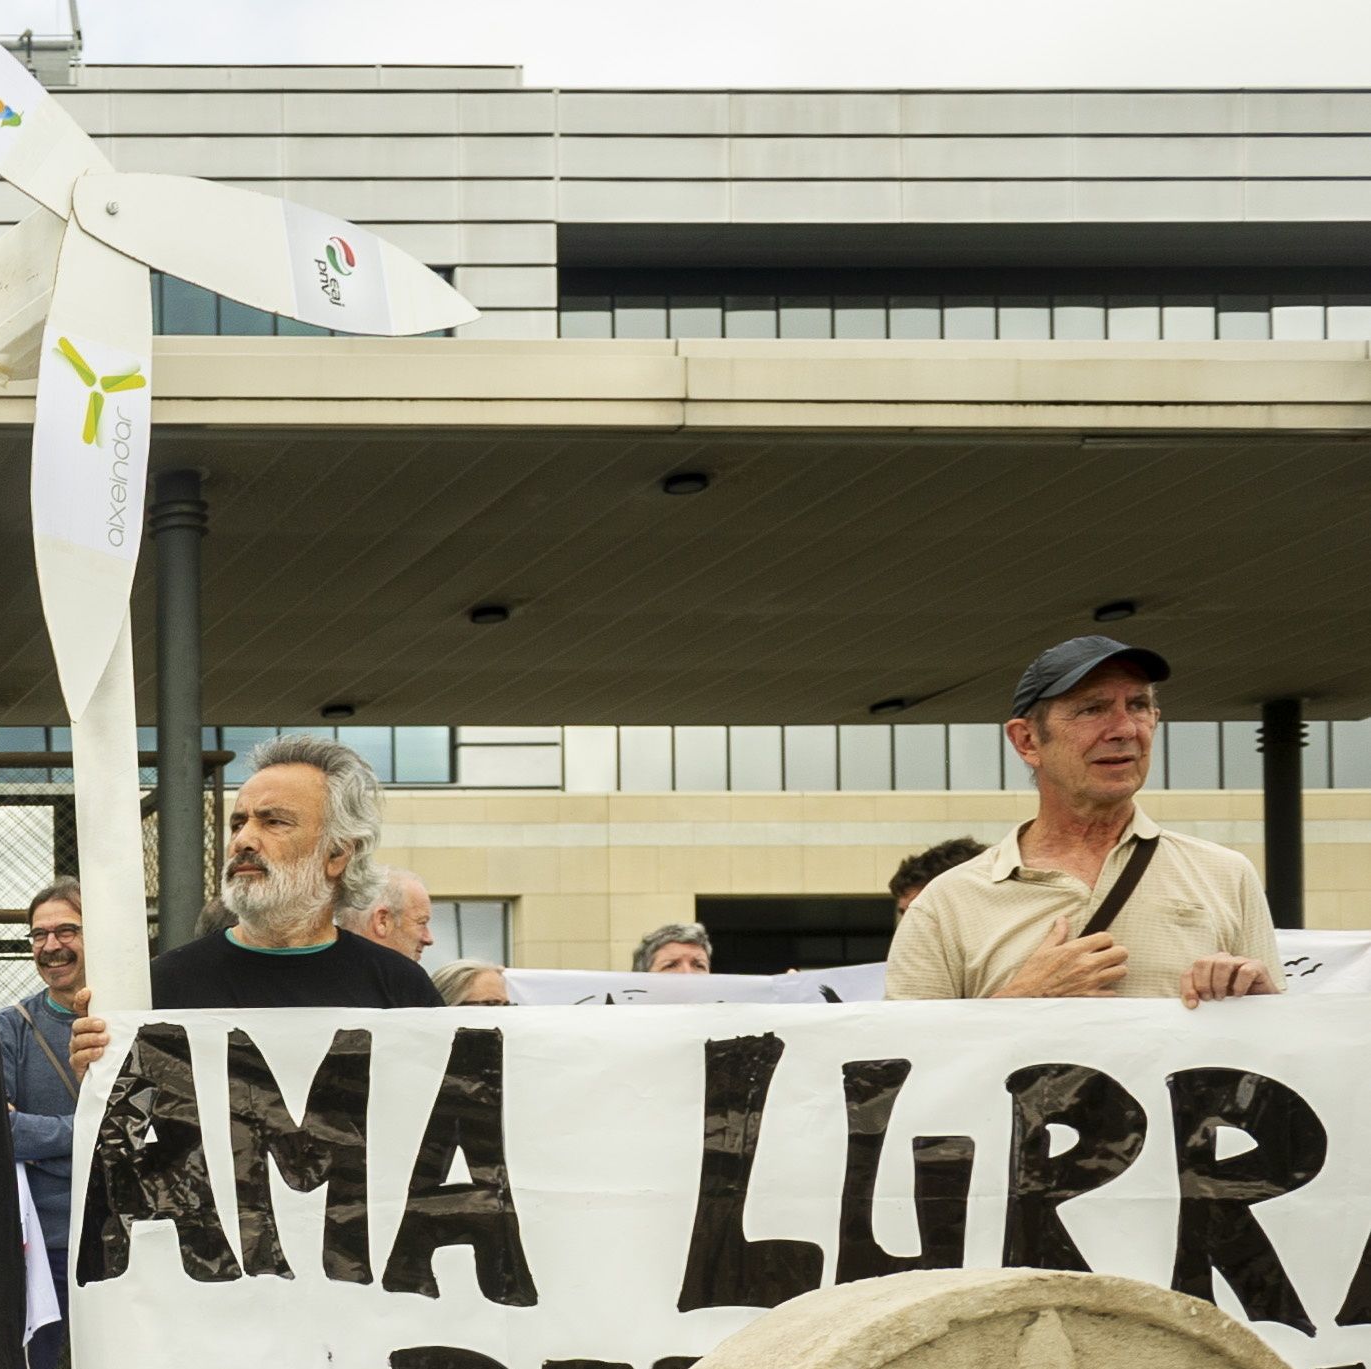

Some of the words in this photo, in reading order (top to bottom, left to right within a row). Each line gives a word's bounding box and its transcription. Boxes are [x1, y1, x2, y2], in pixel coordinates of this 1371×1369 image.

[314, 258, 331, 296] pnv
[106, 405, 132, 548] aixeindar
[75, 1022, 540, 1307] AMA
[677, 1031, 1371, 1338] LURR
